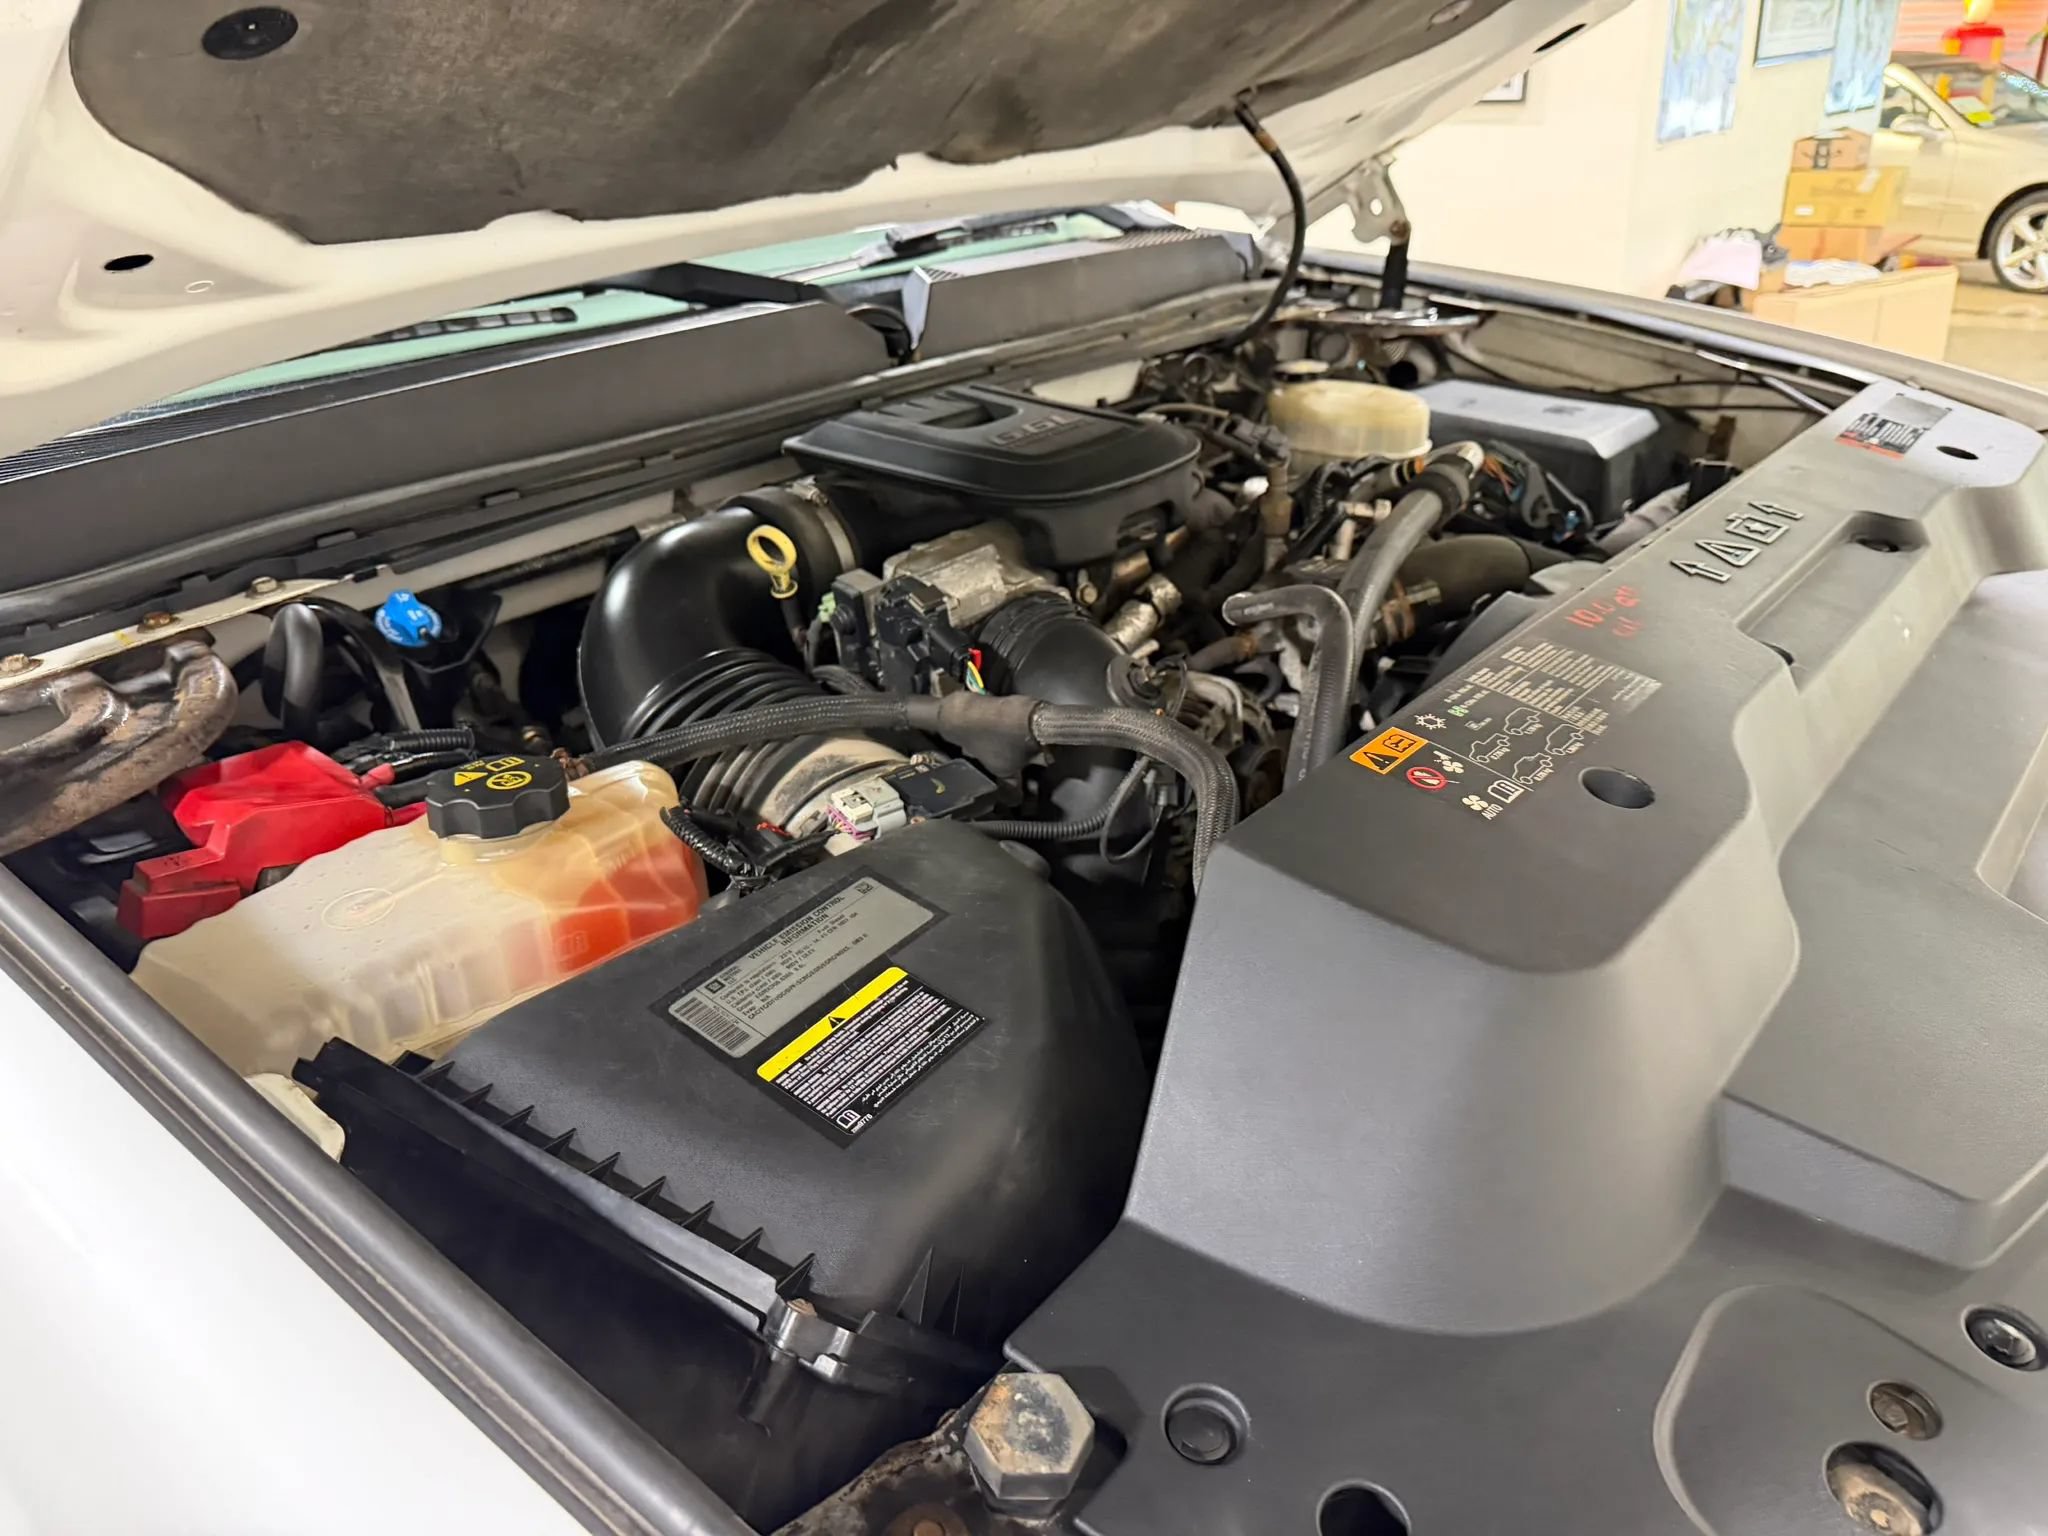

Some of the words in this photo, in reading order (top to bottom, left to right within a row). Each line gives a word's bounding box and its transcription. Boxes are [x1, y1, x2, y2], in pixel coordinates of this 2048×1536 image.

[1479, 803, 1504, 820] AUTO
[748, 938, 780, 959] VEHICLE
[778, 915, 814, 939] EMISSION
[812, 894, 845, 916] CONTROL
[780, 913, 829, 946] INFORMATION
